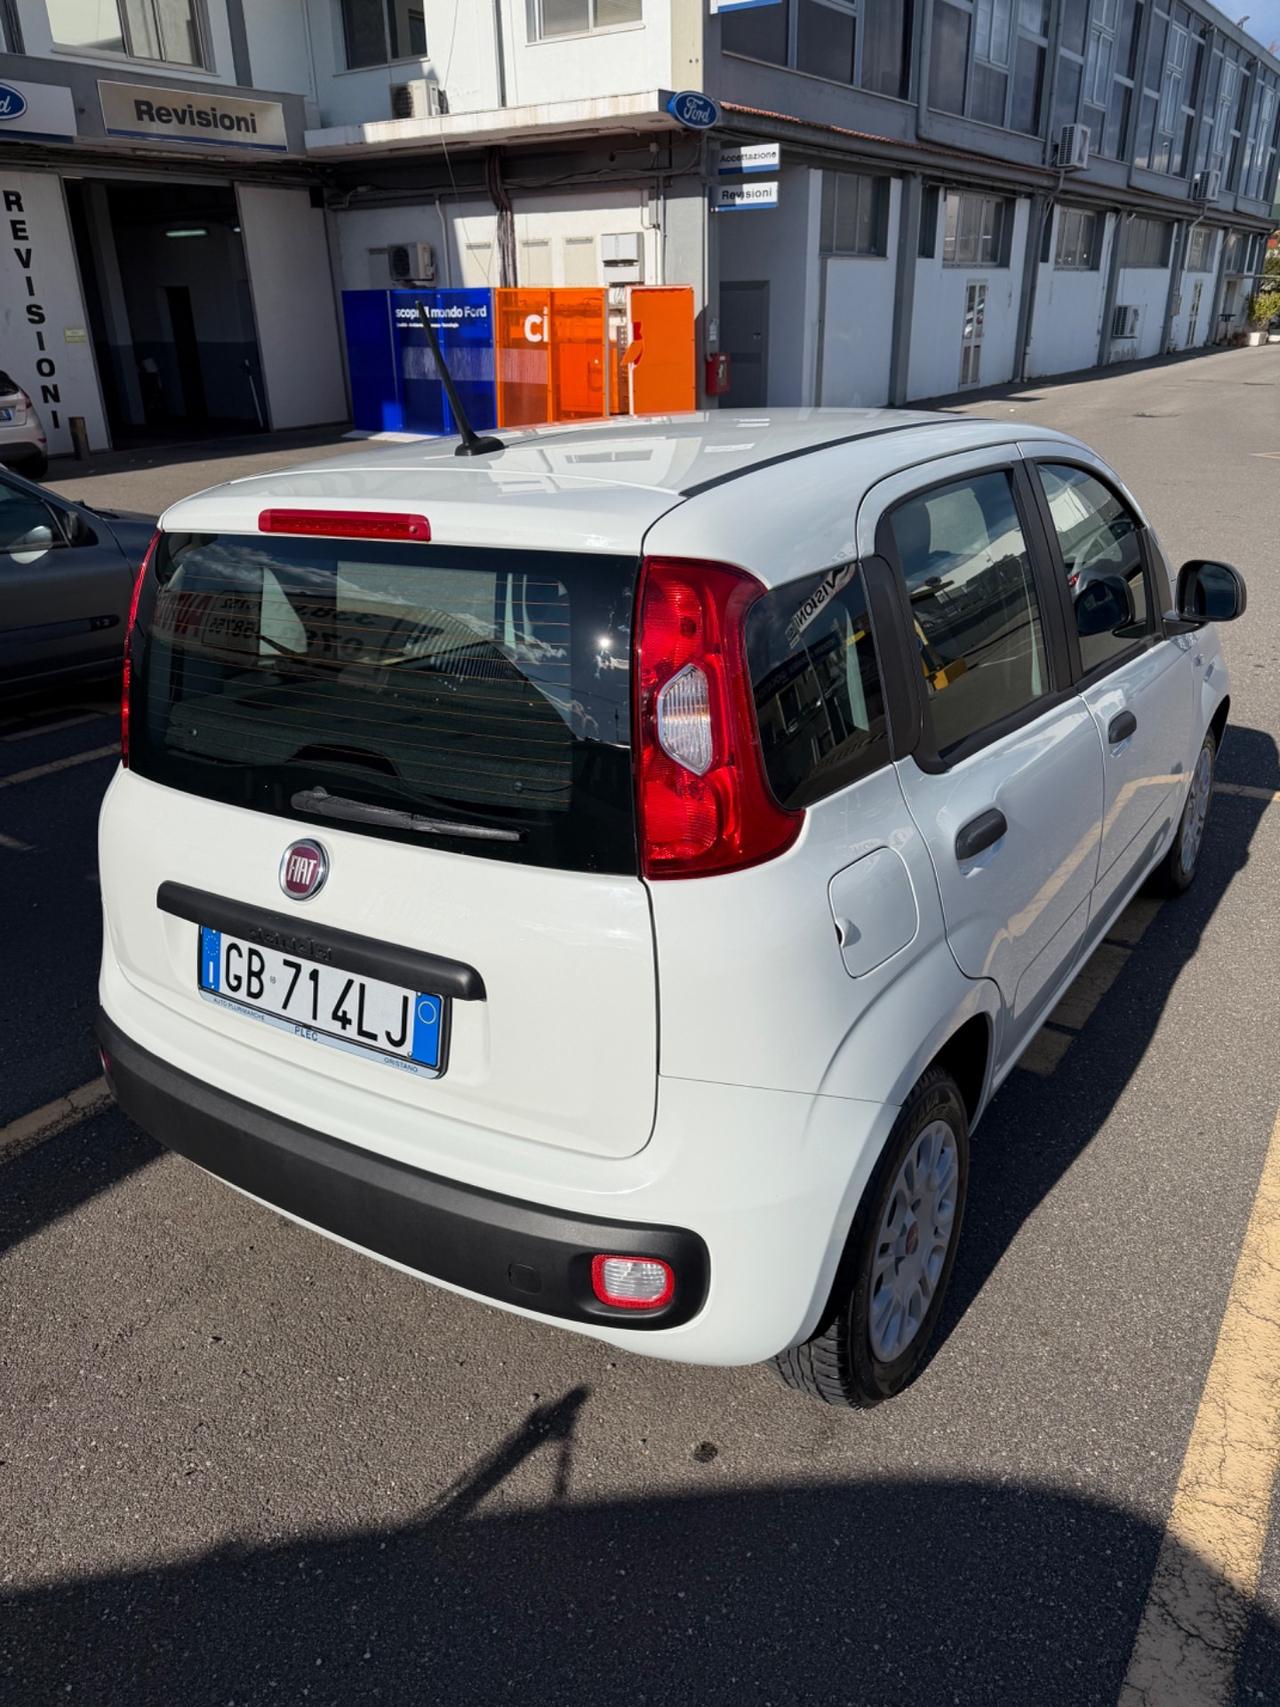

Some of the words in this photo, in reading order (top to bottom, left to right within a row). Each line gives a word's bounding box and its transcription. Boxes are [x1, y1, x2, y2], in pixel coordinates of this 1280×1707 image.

[134, 99, 257, 133] Revisioni
[682, 96, 710, 123] Ford
[721, 151, 777, 163] Accettazione
[721, 187, 772, 201] Revisioni
[2, 190, 61, 429] REVISIONI
[430, 305, 464, 318] mondo
[464, 305, 488, 318] Ford
[287, 854, 318, 885] FIAT
[225, 943, 266, 999] GB
[282, 959, 409, 1048] 714LJ
[295, 1025, 319, 1041] PLEC
[384, 1057, 418, 1074] ORISTANO
